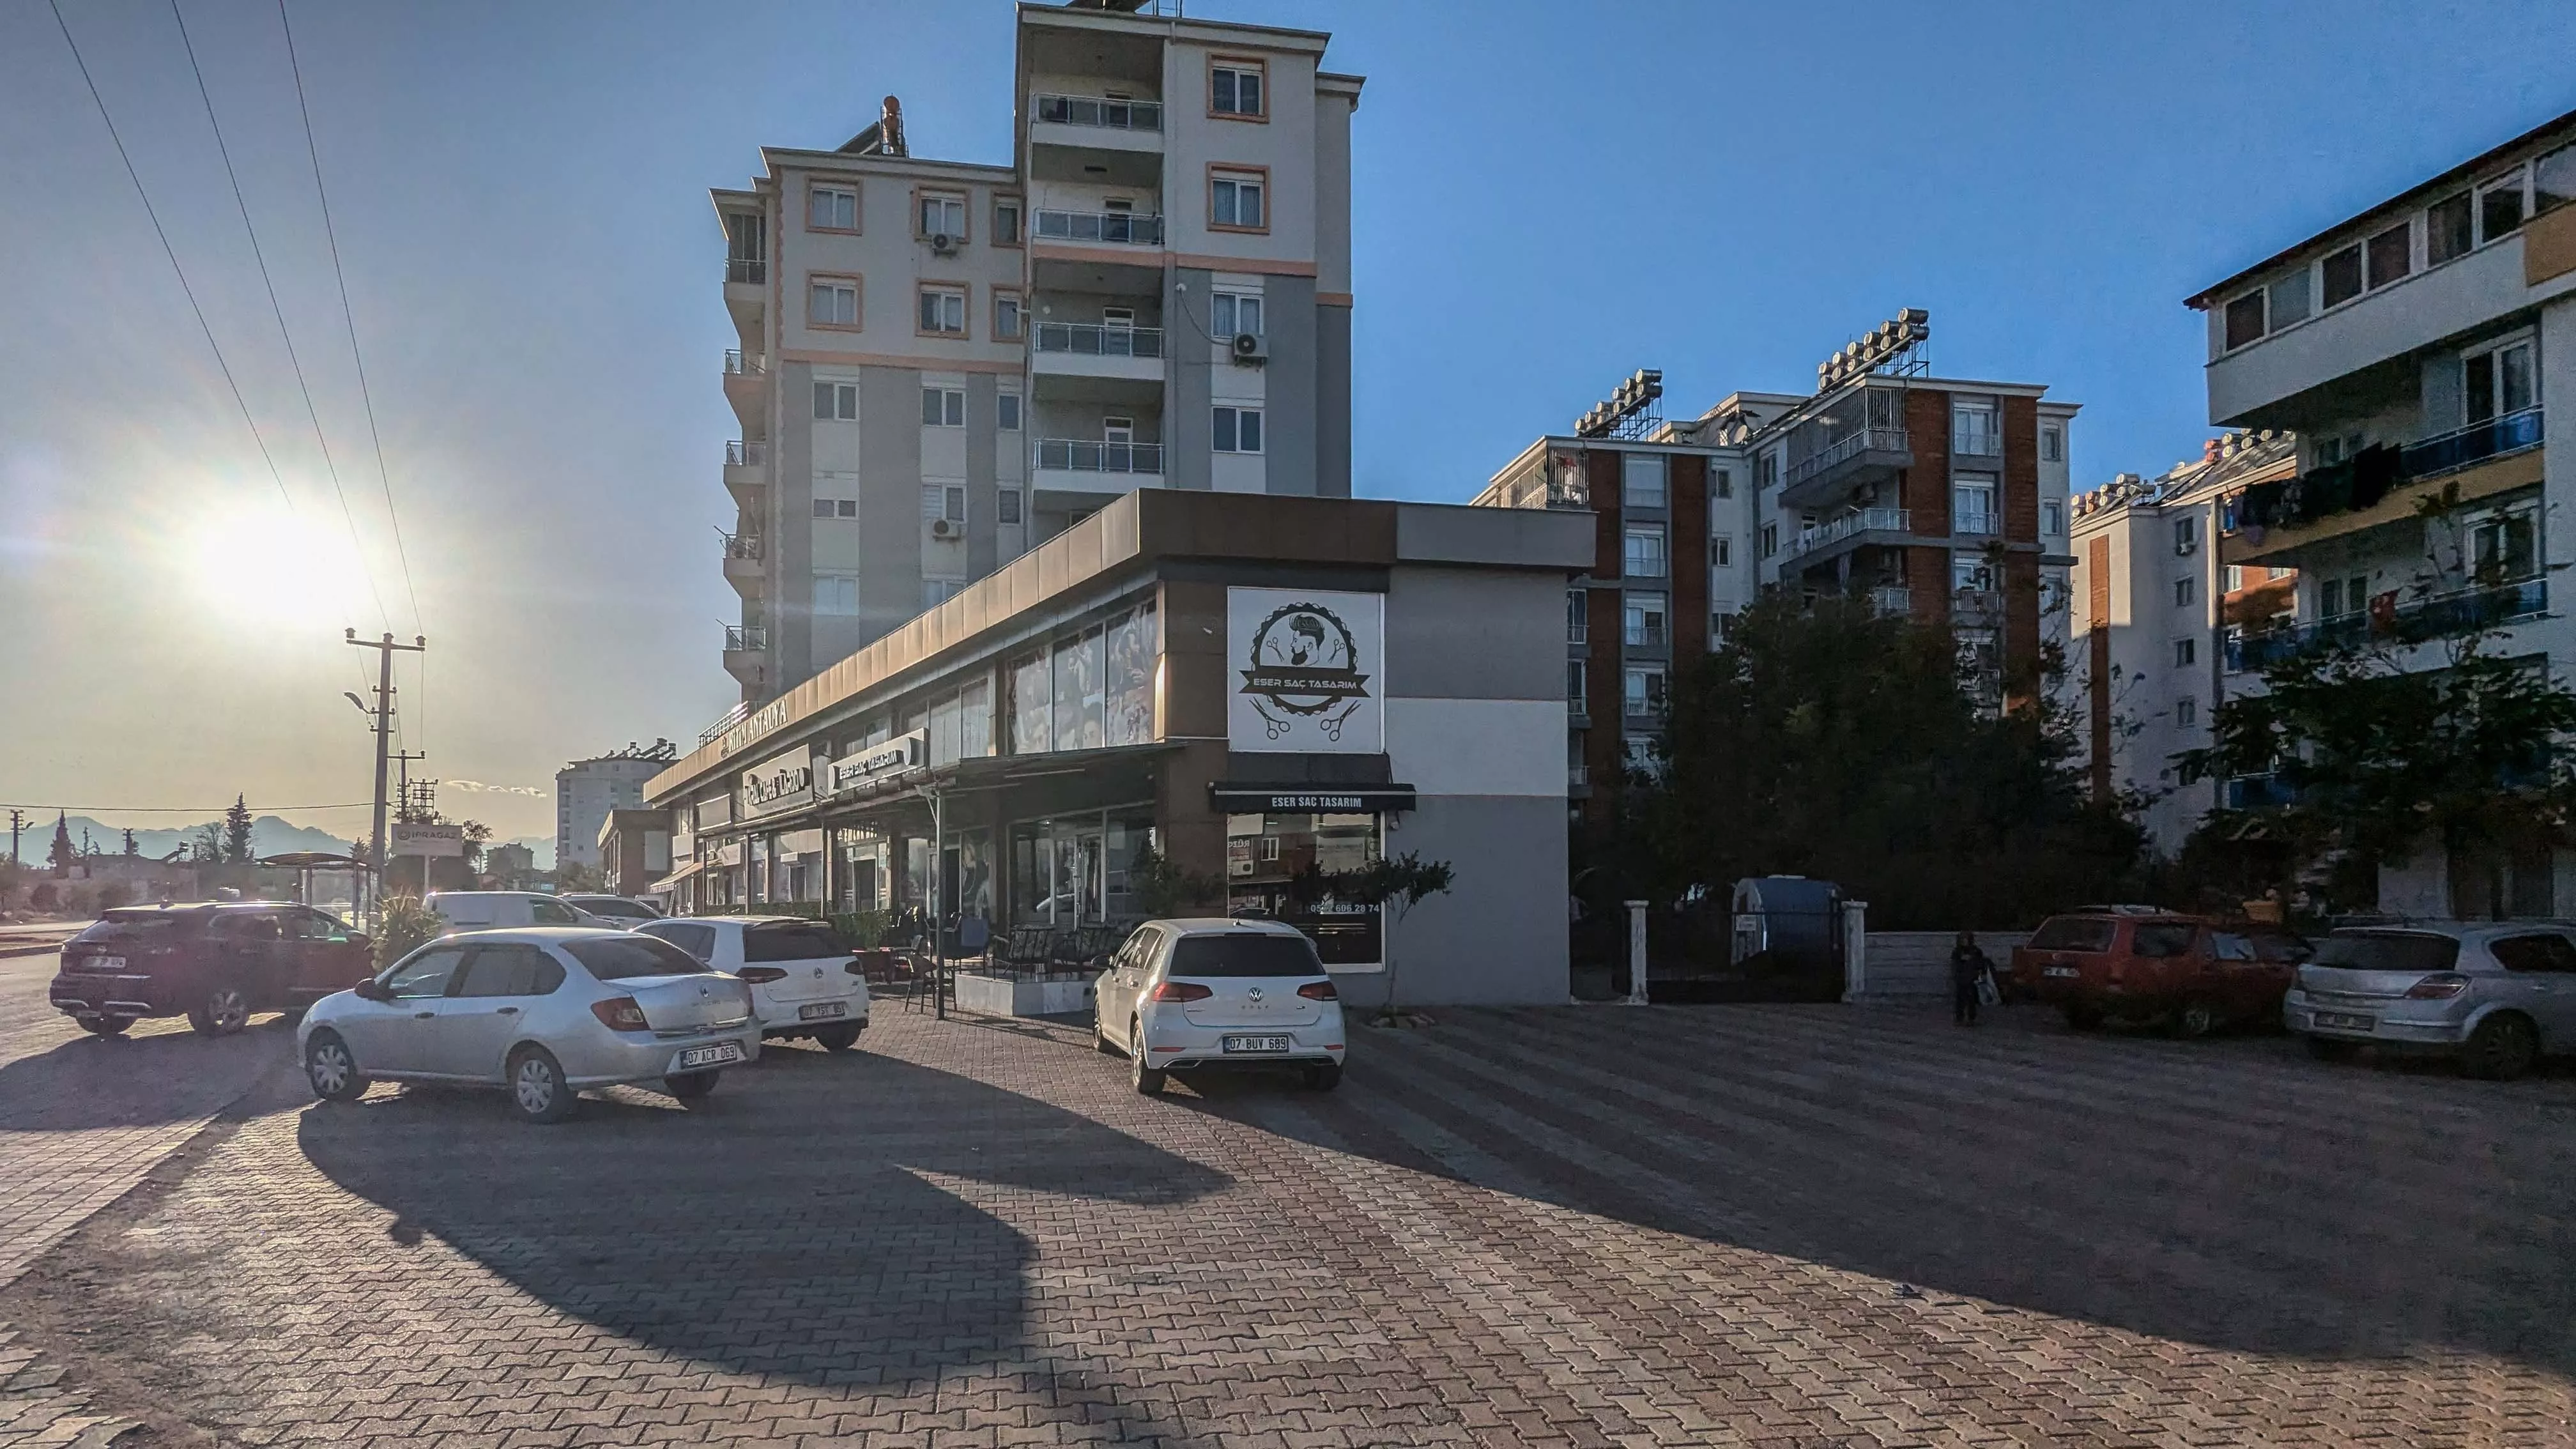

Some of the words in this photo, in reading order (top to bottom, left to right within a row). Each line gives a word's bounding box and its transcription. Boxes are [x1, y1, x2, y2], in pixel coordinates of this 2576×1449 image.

[1284, 680, 1306, 689] SAÇ
[1308, 680, 1357, 689] TASARIM
[839, 764, 854, 779] ESER
[868, 749, 897, 770] TASARIM
[1271, 797, 1296, 807] ESER
[1319, 797, 1361, 808] TASARIM
[1335, 904, 1352, 912] 606
[1354, 904, 1365, 912] 28
[1368, 904, 1379, 912] 74
[1230, 1038, 1241, 1049] 07
[1246, 1038, 1264, 1049] BUV
[1268, 1038, 1286, 1049] 689
[688, 1052, 698, 1064] 07
[702, 1049, 716, 1062] ACR
[721, 1046, 735, 1059] 069
